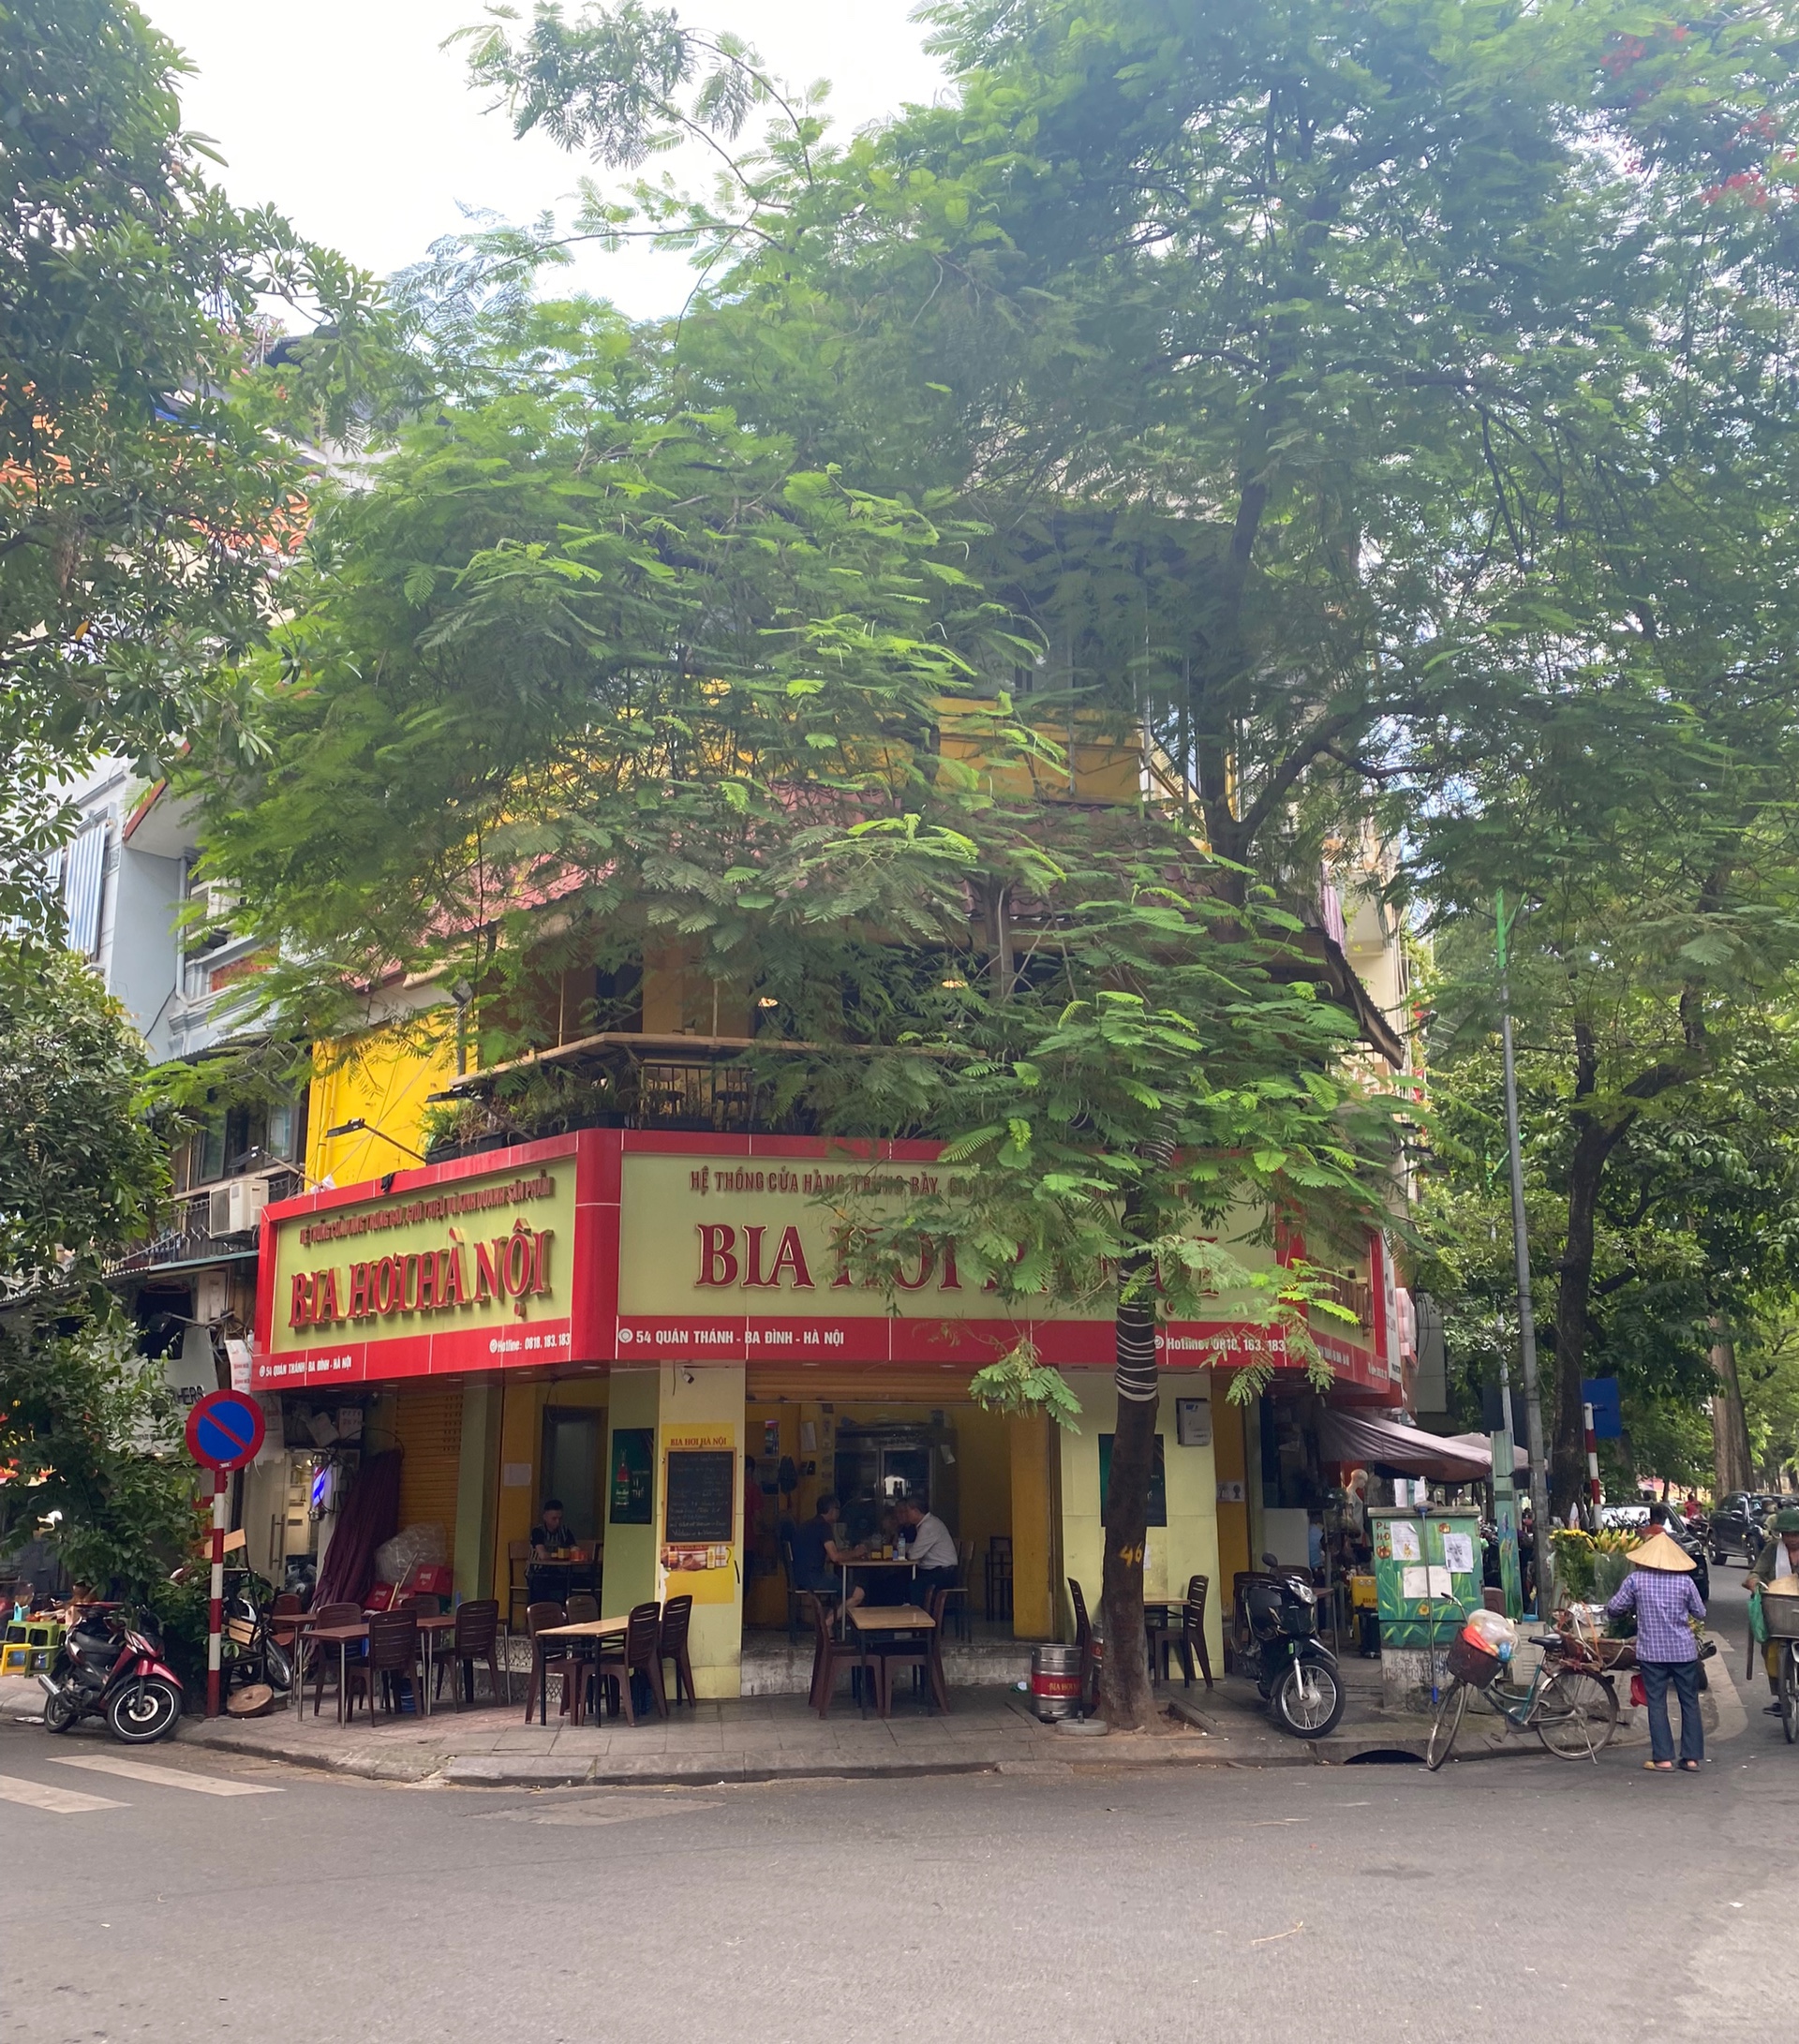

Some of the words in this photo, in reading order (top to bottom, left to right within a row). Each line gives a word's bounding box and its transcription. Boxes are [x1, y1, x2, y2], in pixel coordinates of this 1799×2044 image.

[691, 1165, 709, 1196] HỆ
[715, 1166, 764, 1192] THỐNG
[767, 1165, 798, 1192] CỬA
[694, 1223, 816, 1290] BIA
[289, 1267, 343, 1328] BIA
[347, 1252, 416, 1320] HƠI
[416, 1227, 468, 1312] HÀ
[473, 1218, 554, 1318] NỘI
[558, 1332, 571, 1346] 183
[636, 1330, 651, 1343] 54
[656, 1328, 689, 1345] QUÁN
[693, 1328, 734, 1344] THÁNH
[745, 1330, 761, 1344] BA
[765, 1328, 793, 1344] ĐÌNH
[803, 1327, 820, 1344] HÀ
[824, 1327, 844, 1347] NỘI
[1268, 1340, 1286, 1352] 183
[670, 1438, 683, 1446] BIA
[701, 1436, 711, 1446] HÀ
[713, 1436, 727, 1446] NỘI
